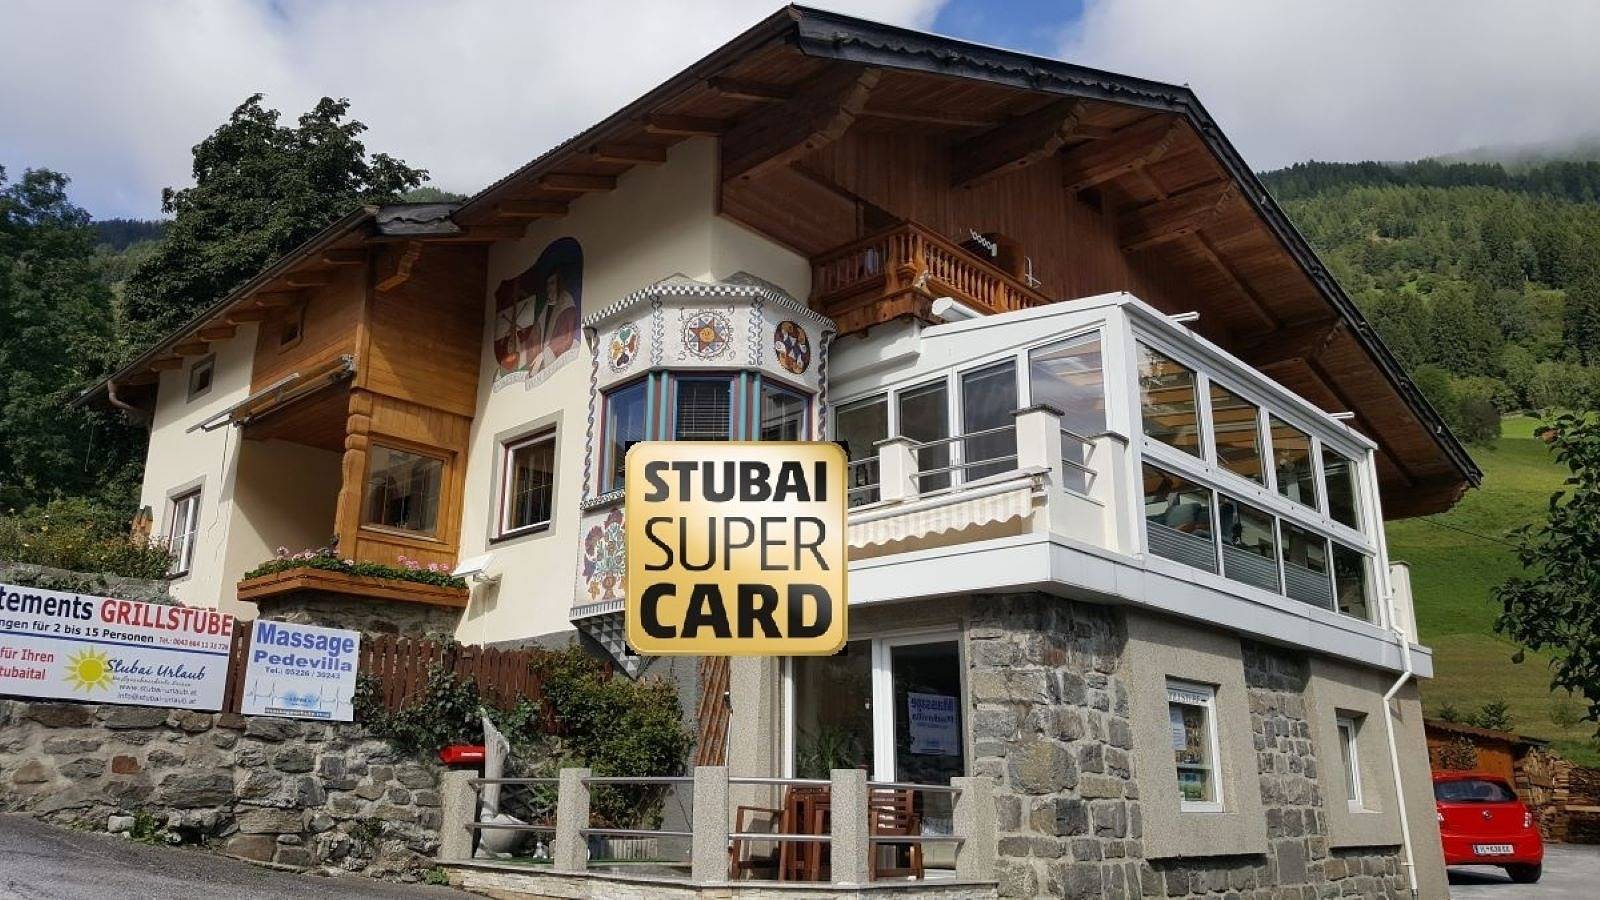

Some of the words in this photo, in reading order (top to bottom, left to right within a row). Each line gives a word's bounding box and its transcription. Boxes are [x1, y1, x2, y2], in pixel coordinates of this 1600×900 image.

[0, 585, 94, 620] tements
[100, 600, 234, 636] GRILLSTUBE
[32, 621, 50, 632] für
[53, 623, 61, 633] 2
[64, 625, 81, 635] bis
[85, 627, 99, 637] 15
[101, 628, 154, 643] Personen
[256, 622, 355, 658] Massage
[0, 646, 18, 660] für
[21, 648, 54, 663] Ihren
[254, 649, 353, 672] Pedevilla
[104, 658, 153, 675] Stubai
[157, 664, 206, 681] Urlaub
